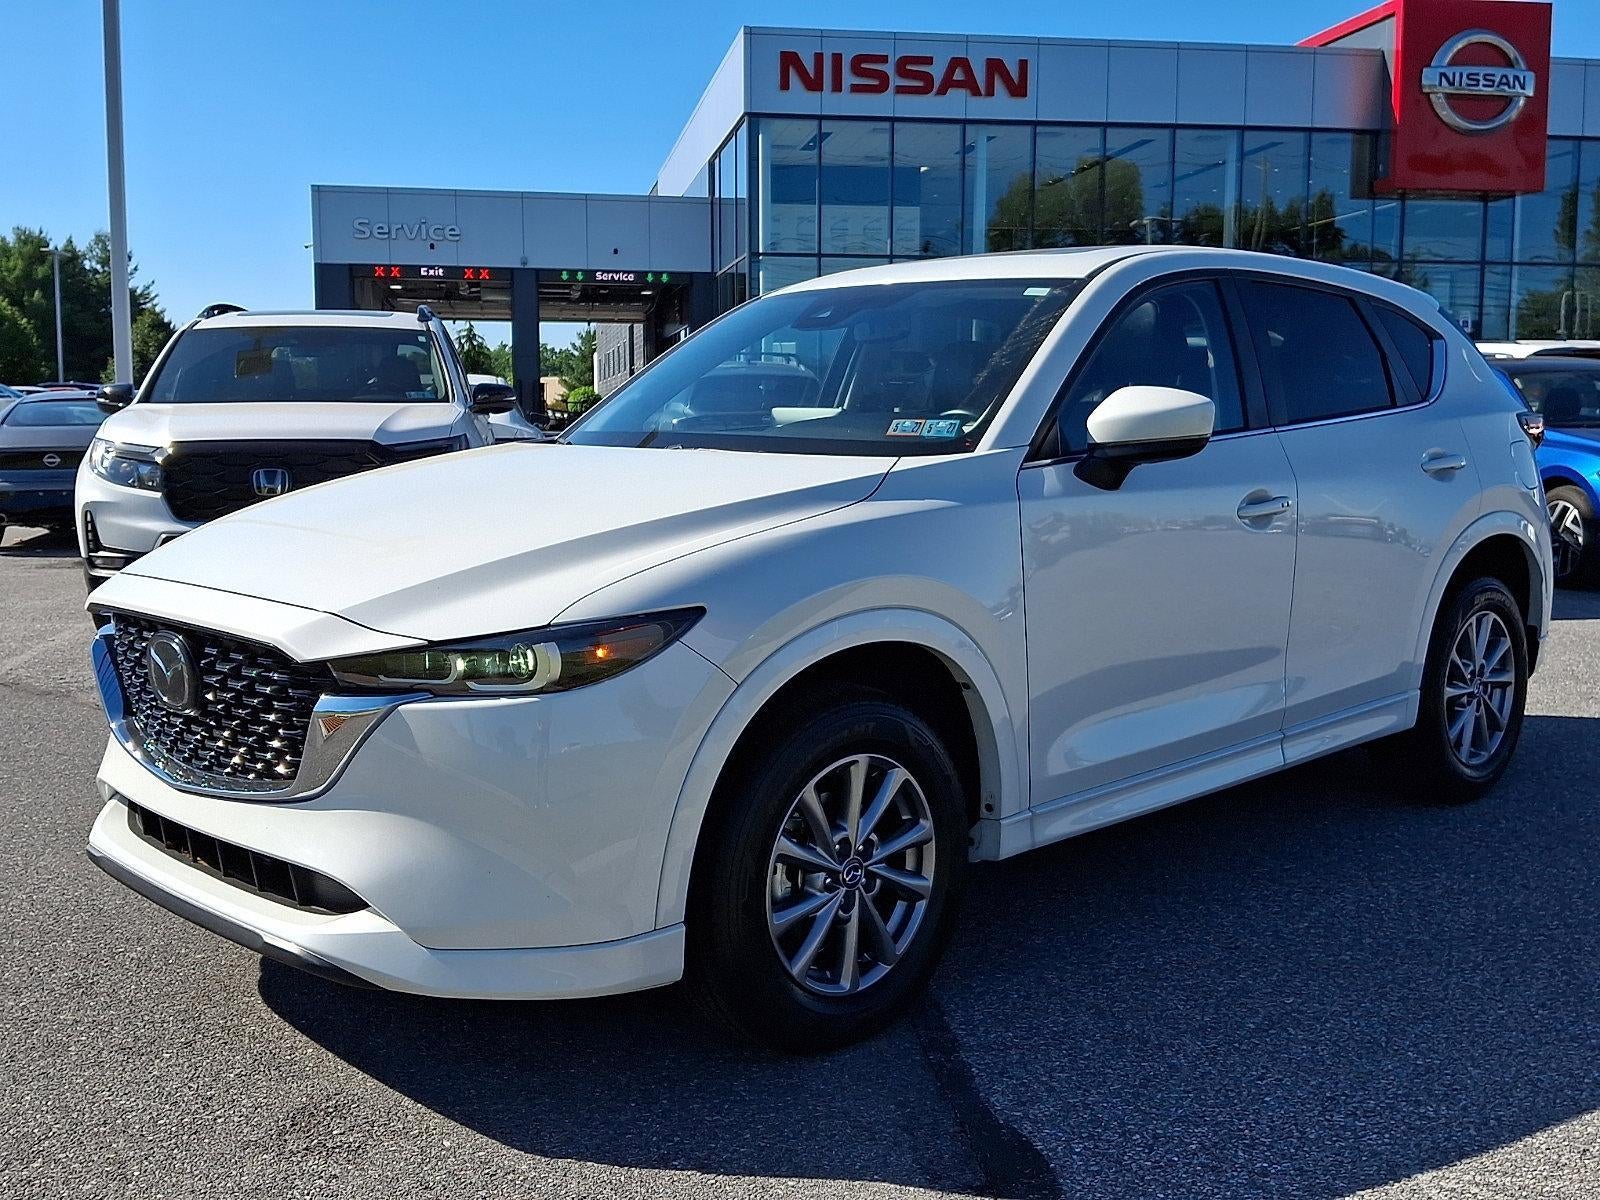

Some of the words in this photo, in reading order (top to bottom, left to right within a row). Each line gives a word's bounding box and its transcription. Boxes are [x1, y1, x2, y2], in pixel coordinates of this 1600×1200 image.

[779, 50, 1028, 98] NISSAN
[1438, 71, 1526, 91] NISSAN
[352, 217, 461, 242] Service
[420, 267, 444, 277] Exit
[595, 271, 635, 281] Service
